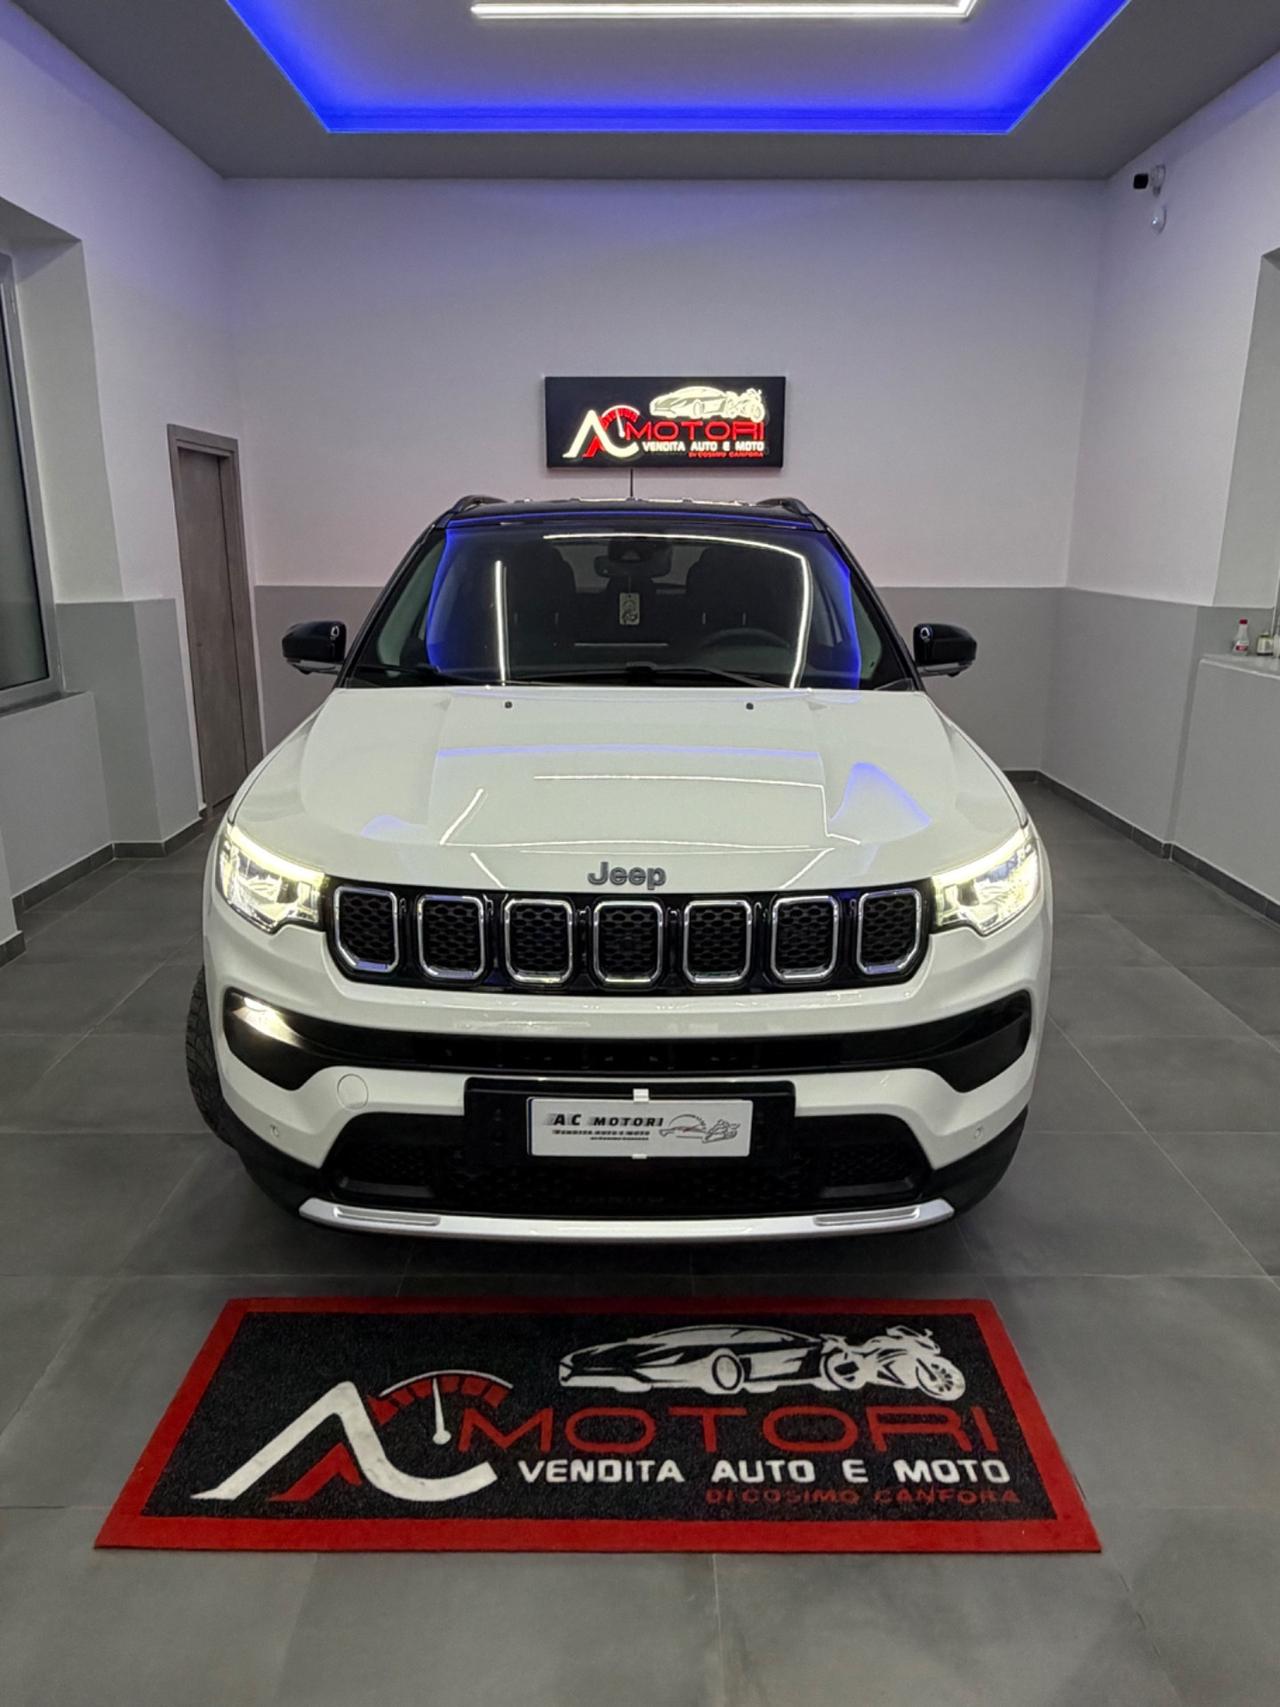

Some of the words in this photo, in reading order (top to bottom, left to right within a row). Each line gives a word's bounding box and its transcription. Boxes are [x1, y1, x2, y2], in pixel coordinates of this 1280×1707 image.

[624, 421, 764, 441] MOTORI
[642, 441, 686, 452] VENDITA
[690, 441, 717, 451] AUTO
[722, 441, 730, 451] E
[735, 441, 765, 451] MOTO
[588, 861, 666, 891] Jeep
[592, 1116, 664, 1127] MOTORI
[457, 1405, 999, 1454] MOTORI
[517, 1458, 685, 1484] VENDITA
[710, 1458, 816, 1484] AUTO
[842, 1458, 869, 1484] E
[894, 1458, 1011, 1484] MOTO
